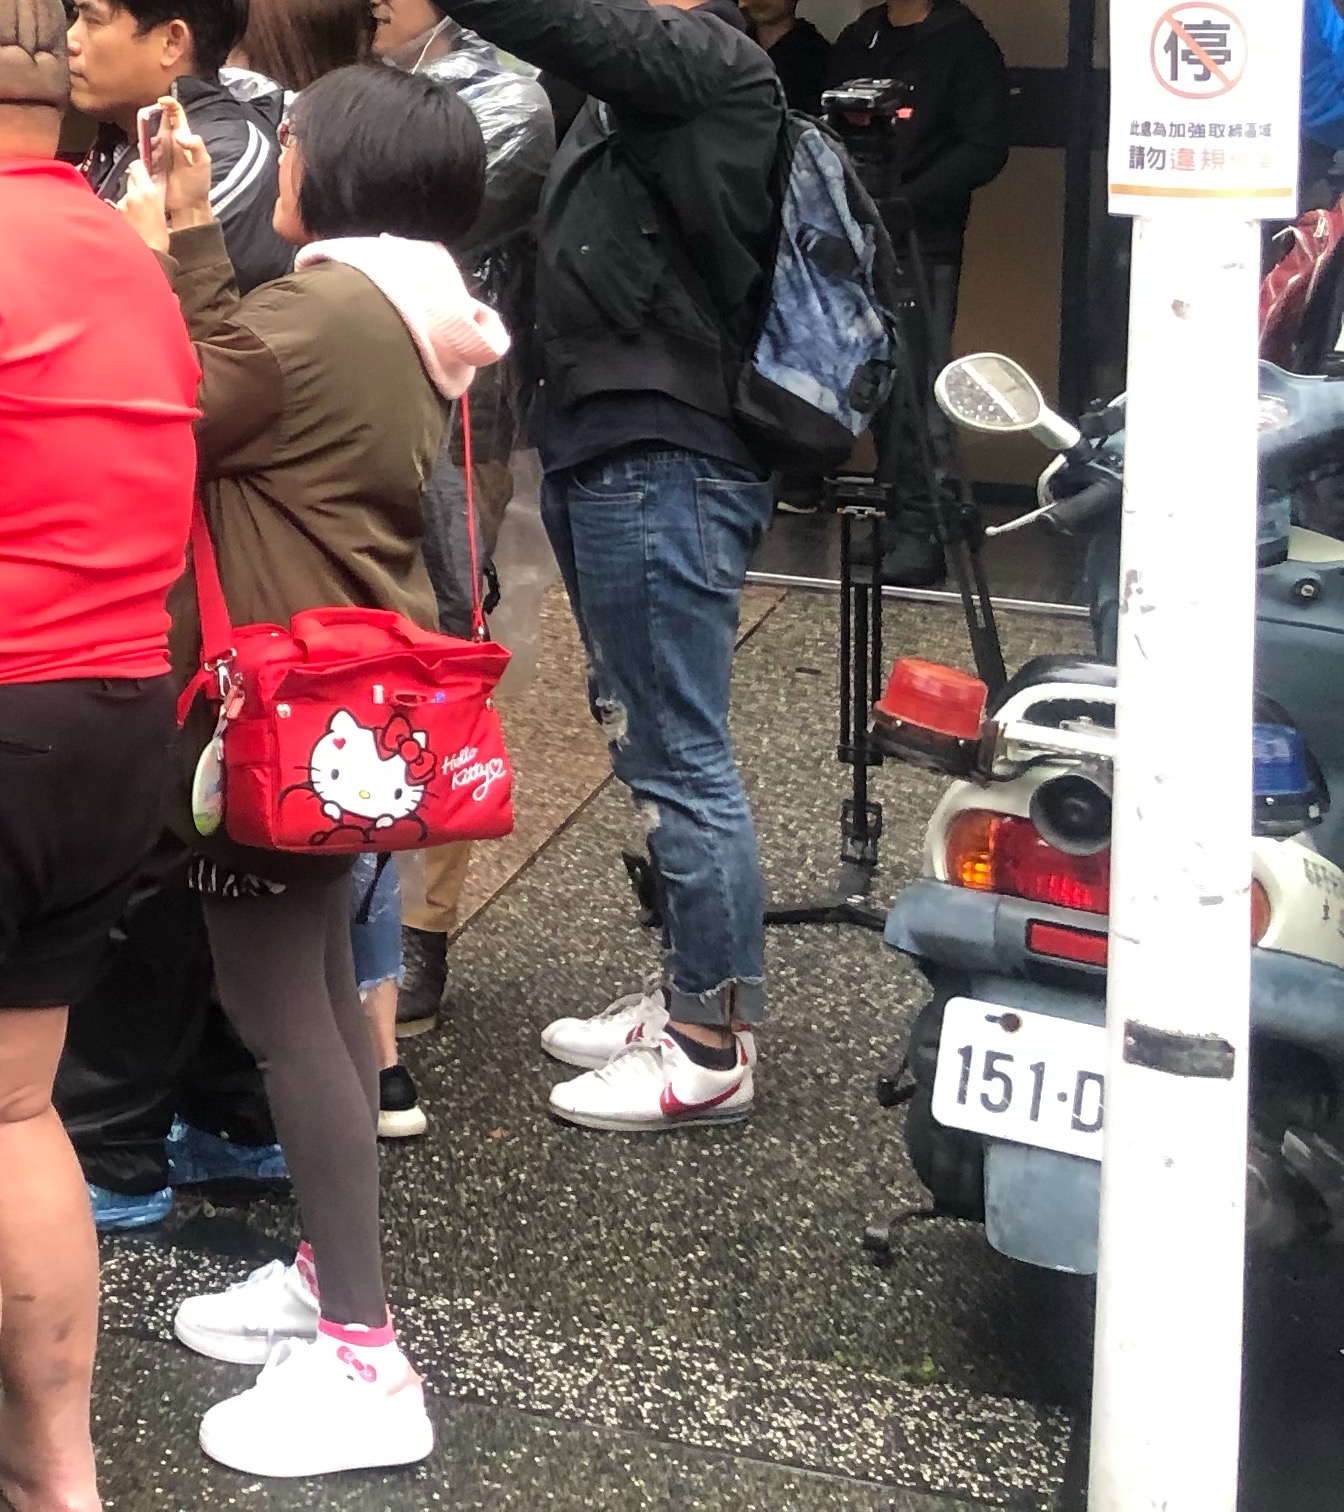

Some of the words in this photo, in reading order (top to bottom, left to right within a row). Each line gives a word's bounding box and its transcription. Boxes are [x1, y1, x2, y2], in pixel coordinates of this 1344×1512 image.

[1163, 19, 1232, 83] 停
[1128, 145, 1274, 171] 請勿違規
[441, 745, 479, 776] Hello
[451, 759, 507, 802] Kitty
